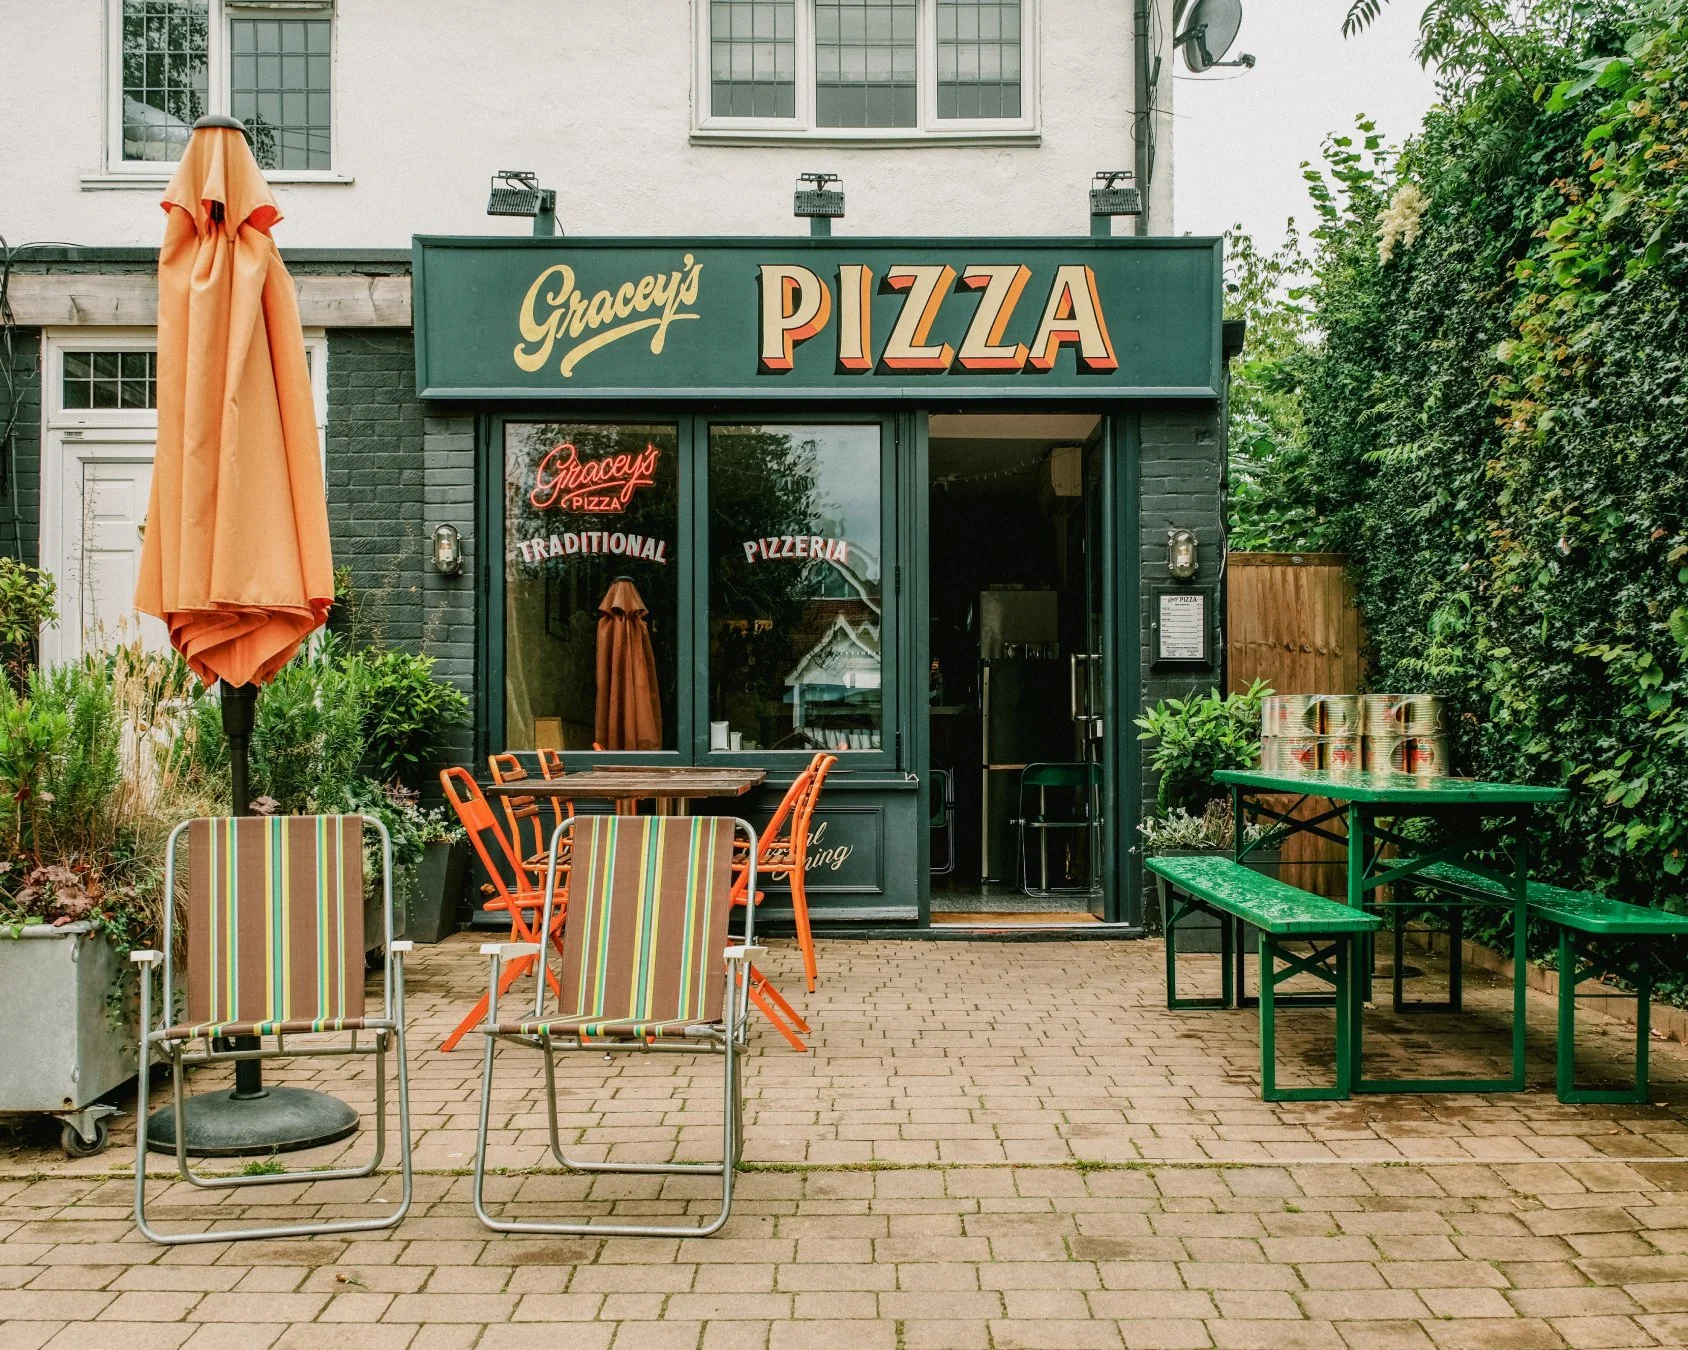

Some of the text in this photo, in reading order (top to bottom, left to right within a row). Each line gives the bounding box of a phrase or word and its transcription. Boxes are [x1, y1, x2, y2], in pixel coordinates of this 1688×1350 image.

[513, 253, 1119, 378] Gracey's PIZZA
[530, 444, 659, 507] Gracey's
[572, 496, 622, 510] PIZZA
[516, 531, 848, 565] TRADITIONAL PIZZERIA
